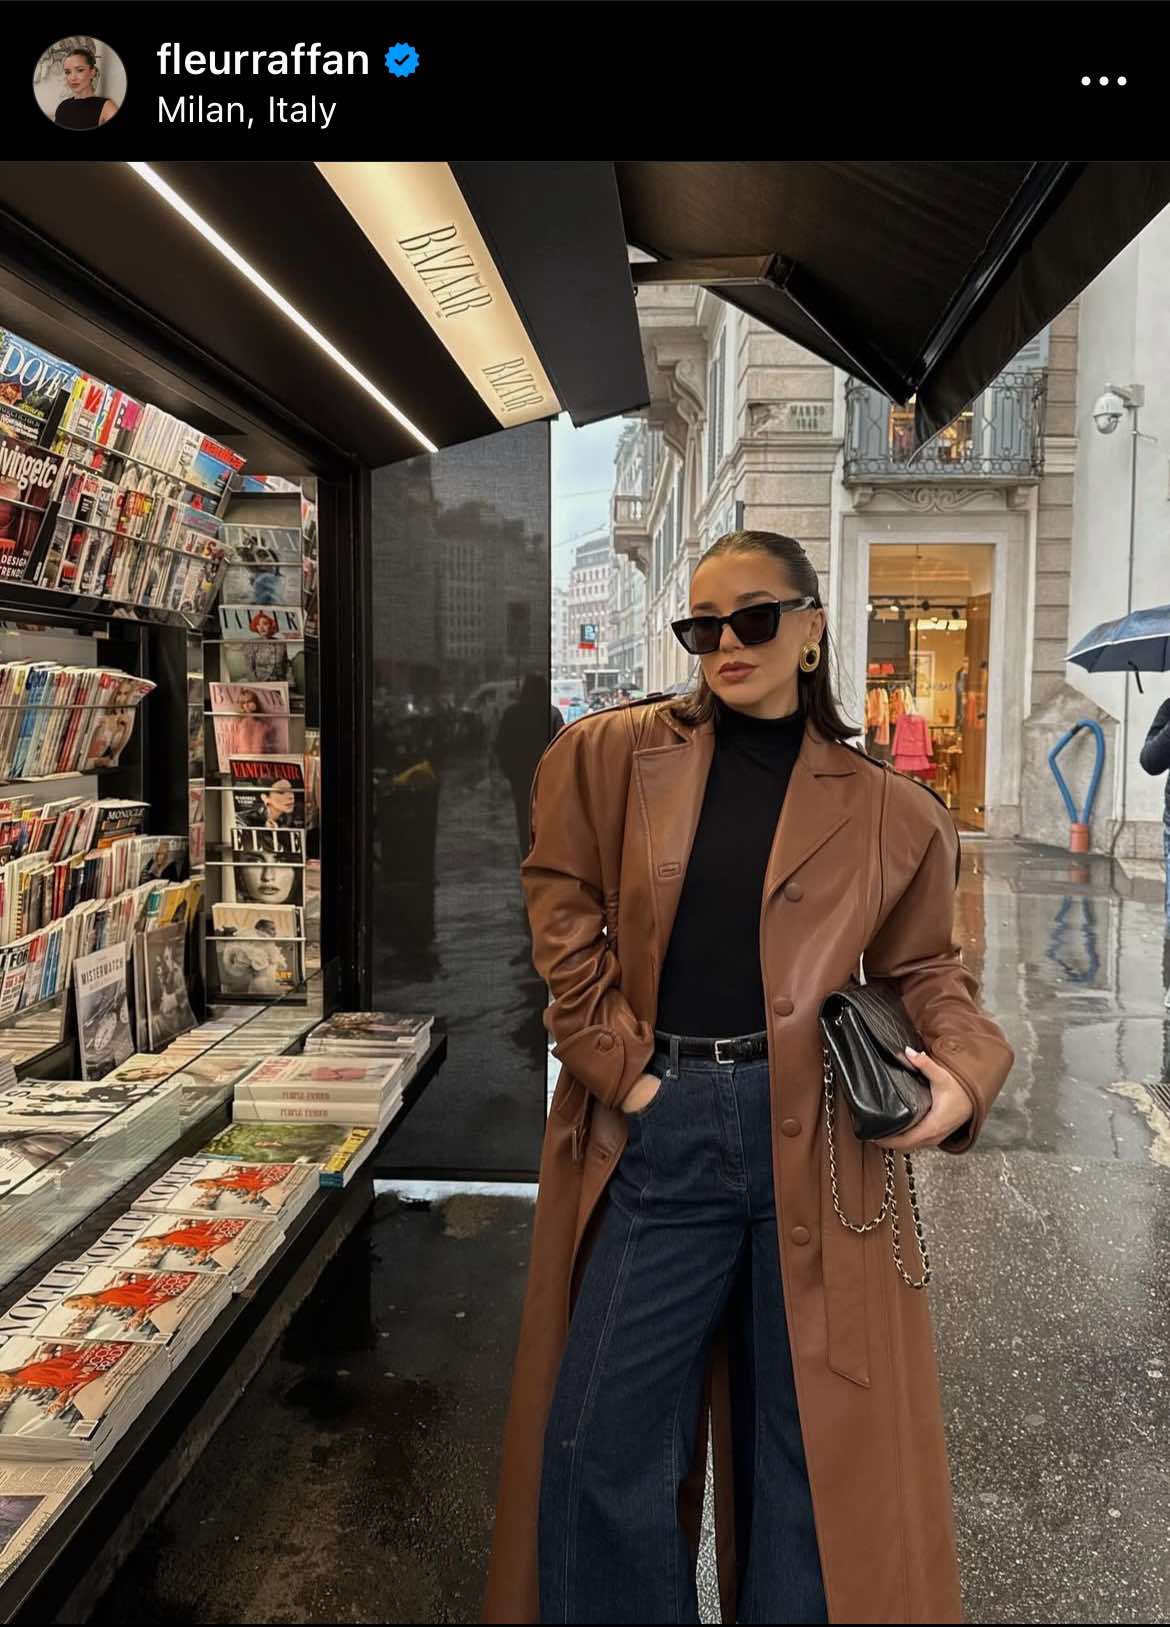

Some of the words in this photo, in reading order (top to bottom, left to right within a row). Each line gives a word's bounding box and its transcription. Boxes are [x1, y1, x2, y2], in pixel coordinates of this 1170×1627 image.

[0, 343, 69, 398] DOVE
[232, 762, 271, 779] VANITY
[107, 808, 145, 821] MONOCLE
[232, 829, 301, 853] ELLE
[137, 1158, 208, 1204] VOGUE
